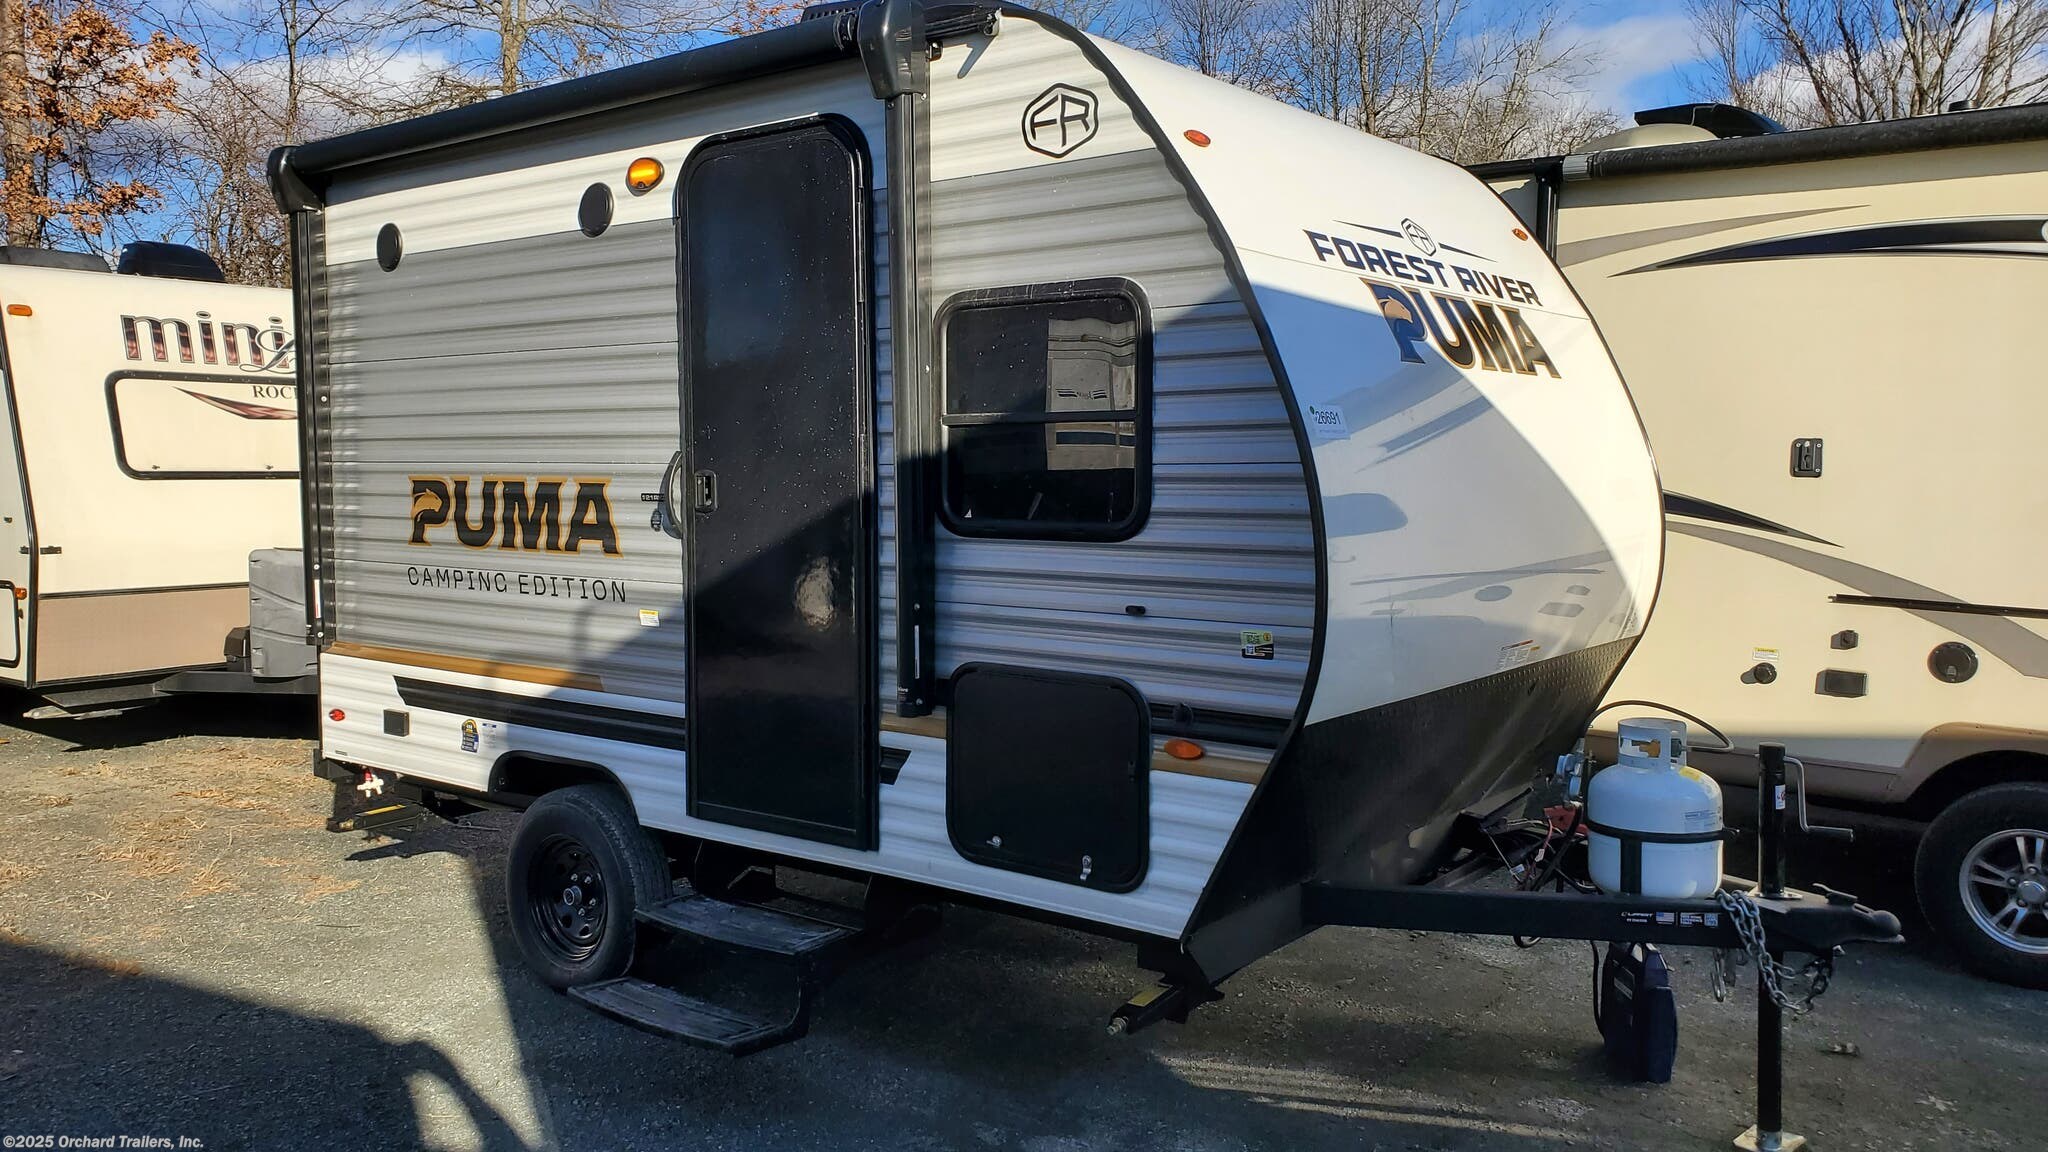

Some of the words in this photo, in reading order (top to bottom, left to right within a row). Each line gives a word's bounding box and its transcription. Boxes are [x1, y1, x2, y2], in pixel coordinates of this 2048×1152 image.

[1302, 229, 1449, 288] FOREST
[1450, 264, 1543, 307] RIVER
[120, 310, 290, 369] mini
[1358, 277, 1562, 379] PUMA
[1315, 410, 1341, 425] 26691
[408, 475, 624, 558] PUMA
[407, 566, 508, 594] CAMPING
[518, 574, 626, 602] EDITION
